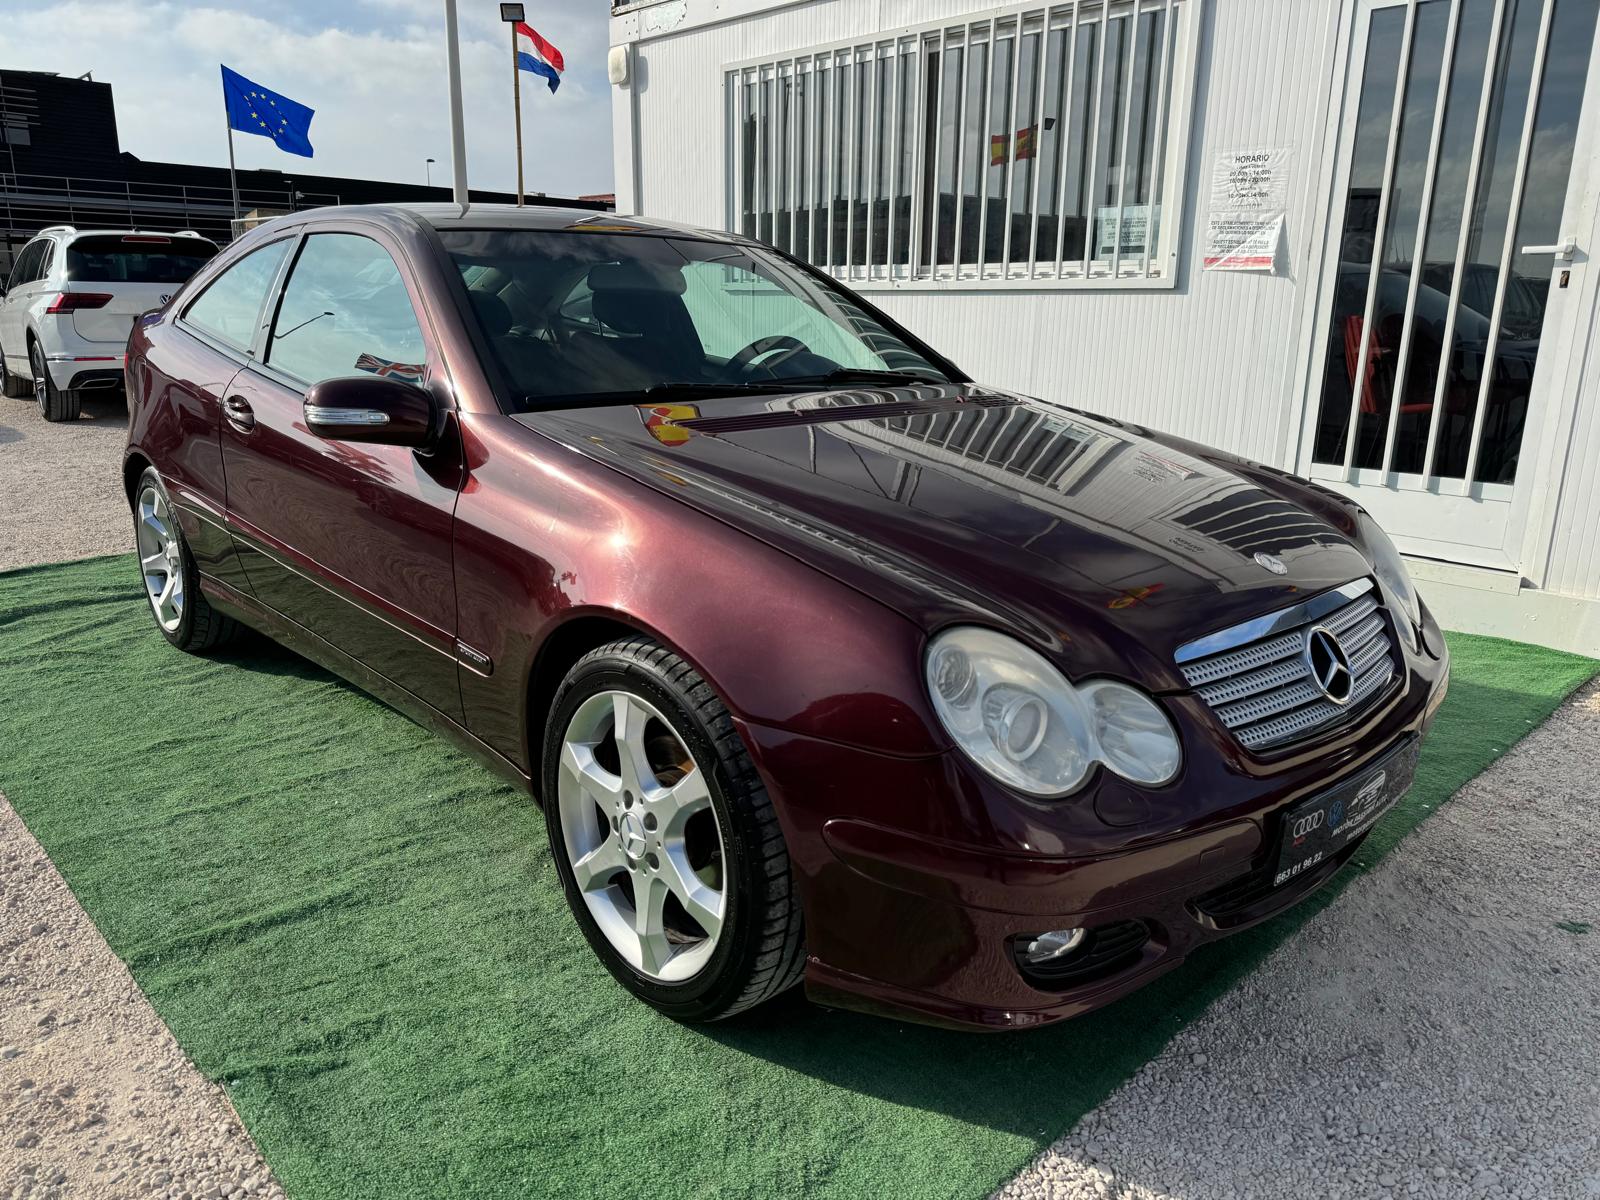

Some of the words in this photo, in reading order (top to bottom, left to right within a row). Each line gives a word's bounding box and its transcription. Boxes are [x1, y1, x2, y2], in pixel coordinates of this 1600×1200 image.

[1235, 154, 1270, 163] HORARIO
[1276, 868, 1291, 884] 663
[1292, 862, 1302, 875] 01
[1302, 856, 1312, 870] 96
[1312, 850, 1323, 864] 22
